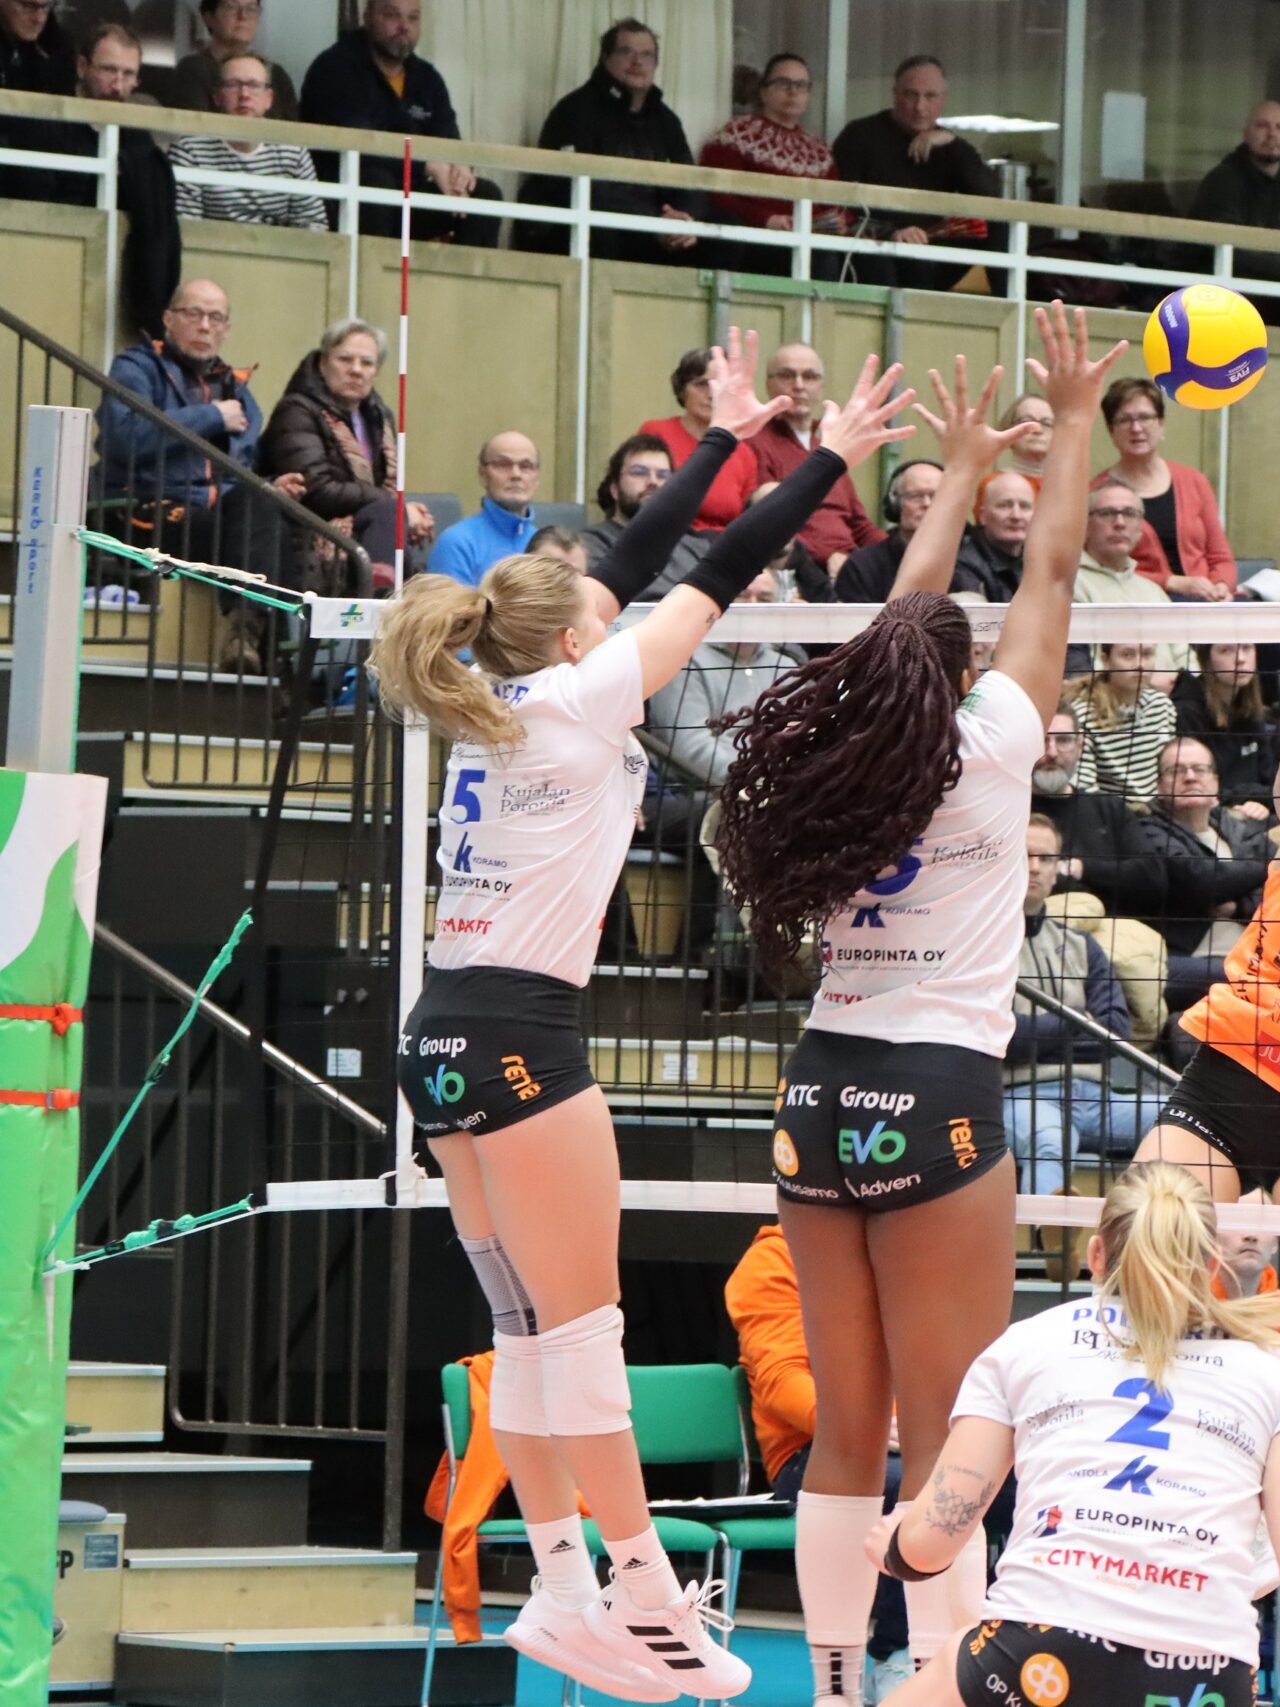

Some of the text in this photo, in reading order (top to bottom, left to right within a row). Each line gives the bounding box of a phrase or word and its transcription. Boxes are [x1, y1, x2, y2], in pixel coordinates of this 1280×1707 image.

[451, 768, 486, 825] 5
[837, 948, 946, 962] EUROPINTA OY
[419, 1036, 467, 1058] Group
[787, 1084, 916, 1117] KTC Group
[838, 1120, 907, 1164] EVO
[860, 1173, 921, 1198] Adven
[1104, 1377, 1175, 1451] 2
[1156, 1477, 1208, 1498] KORAMO
[1075, 1507, 1190, 1537] EUROPINTA
[1195, 1528, 1220, 1546] OY
[1047, 1549, 1209, 1593] CITYMARKET
[986, 1673, 1008, 1695] OP
